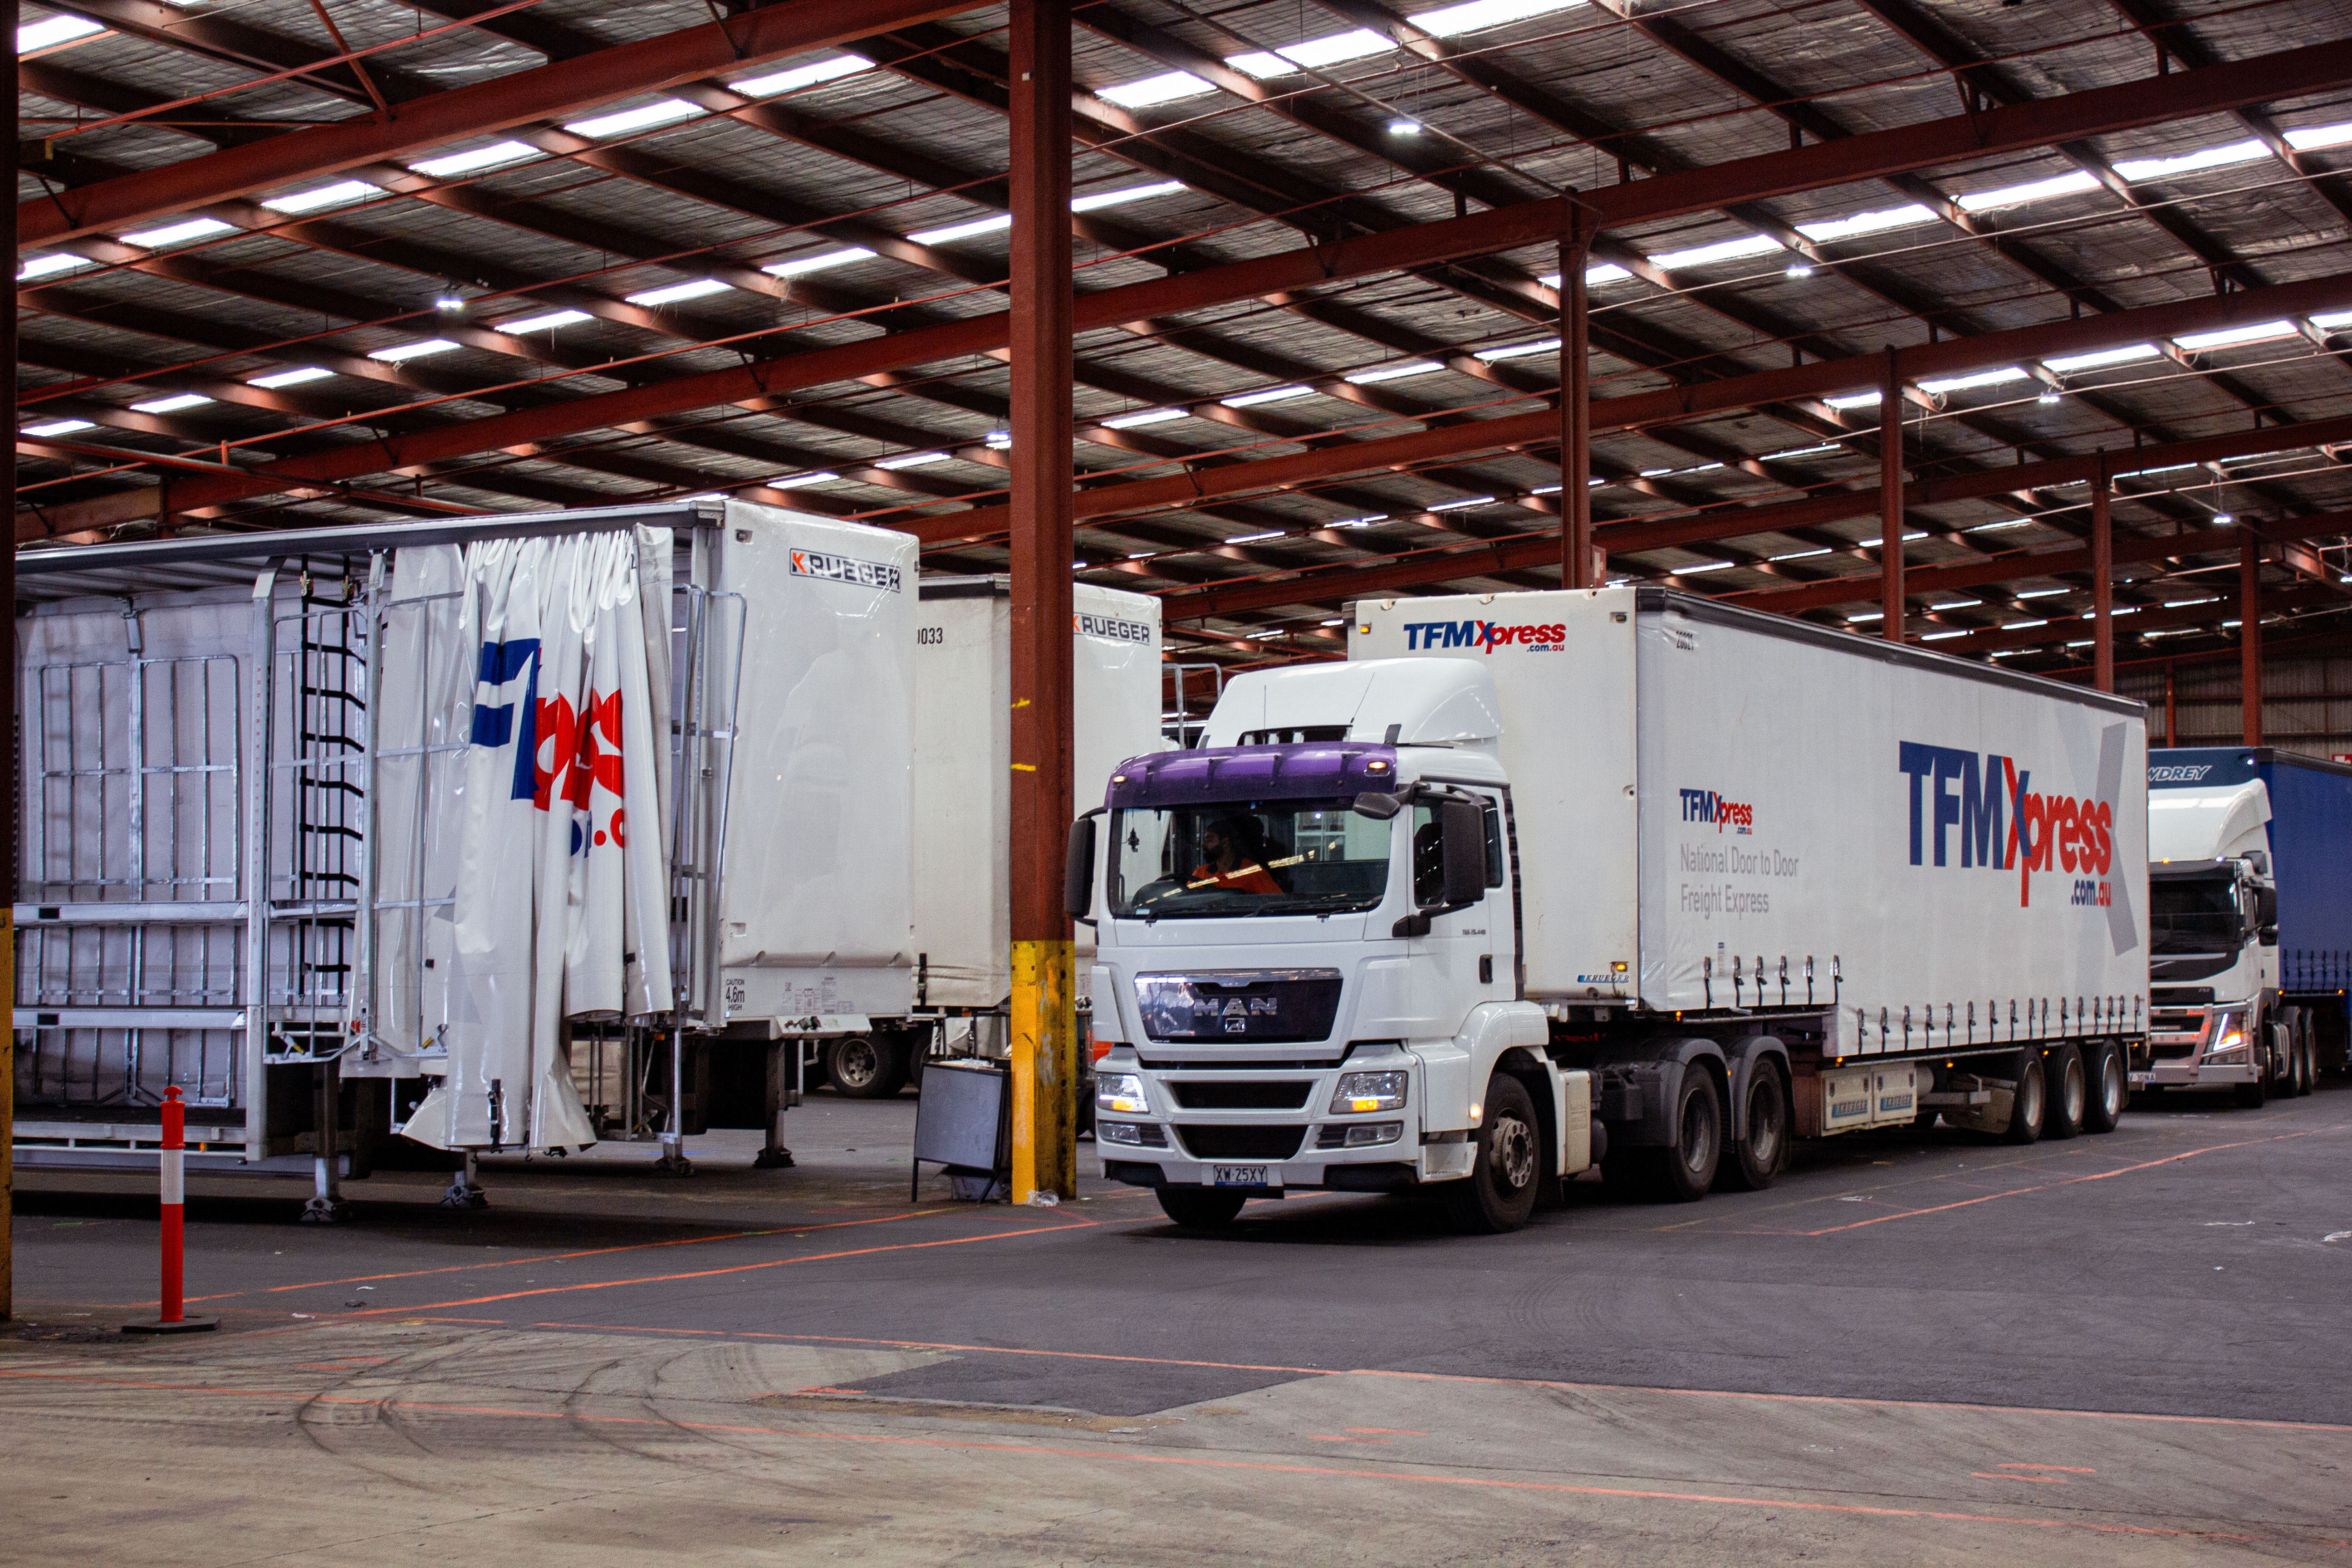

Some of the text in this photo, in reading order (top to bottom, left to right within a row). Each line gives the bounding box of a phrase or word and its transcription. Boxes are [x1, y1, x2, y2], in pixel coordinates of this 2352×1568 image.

[792, 552, 900, 590] KRUEGER
[1403, 620, 1567, 654] TFMXpress
[1527, 644, 1564, 652] .com.au
[1680, 788, 1752, 833] TFMXpress
[1899, 740, 2112, 907] TFMXpress
[1681, 843, 1799, 877] National Door to Door
[1681, 883, 1769, 920] Freight Express
[2071, 879, 2112, 907] .com.au
[725, 986, 745, 1003] 4.6m
[1194, 998, 1277, 1016] MAN
